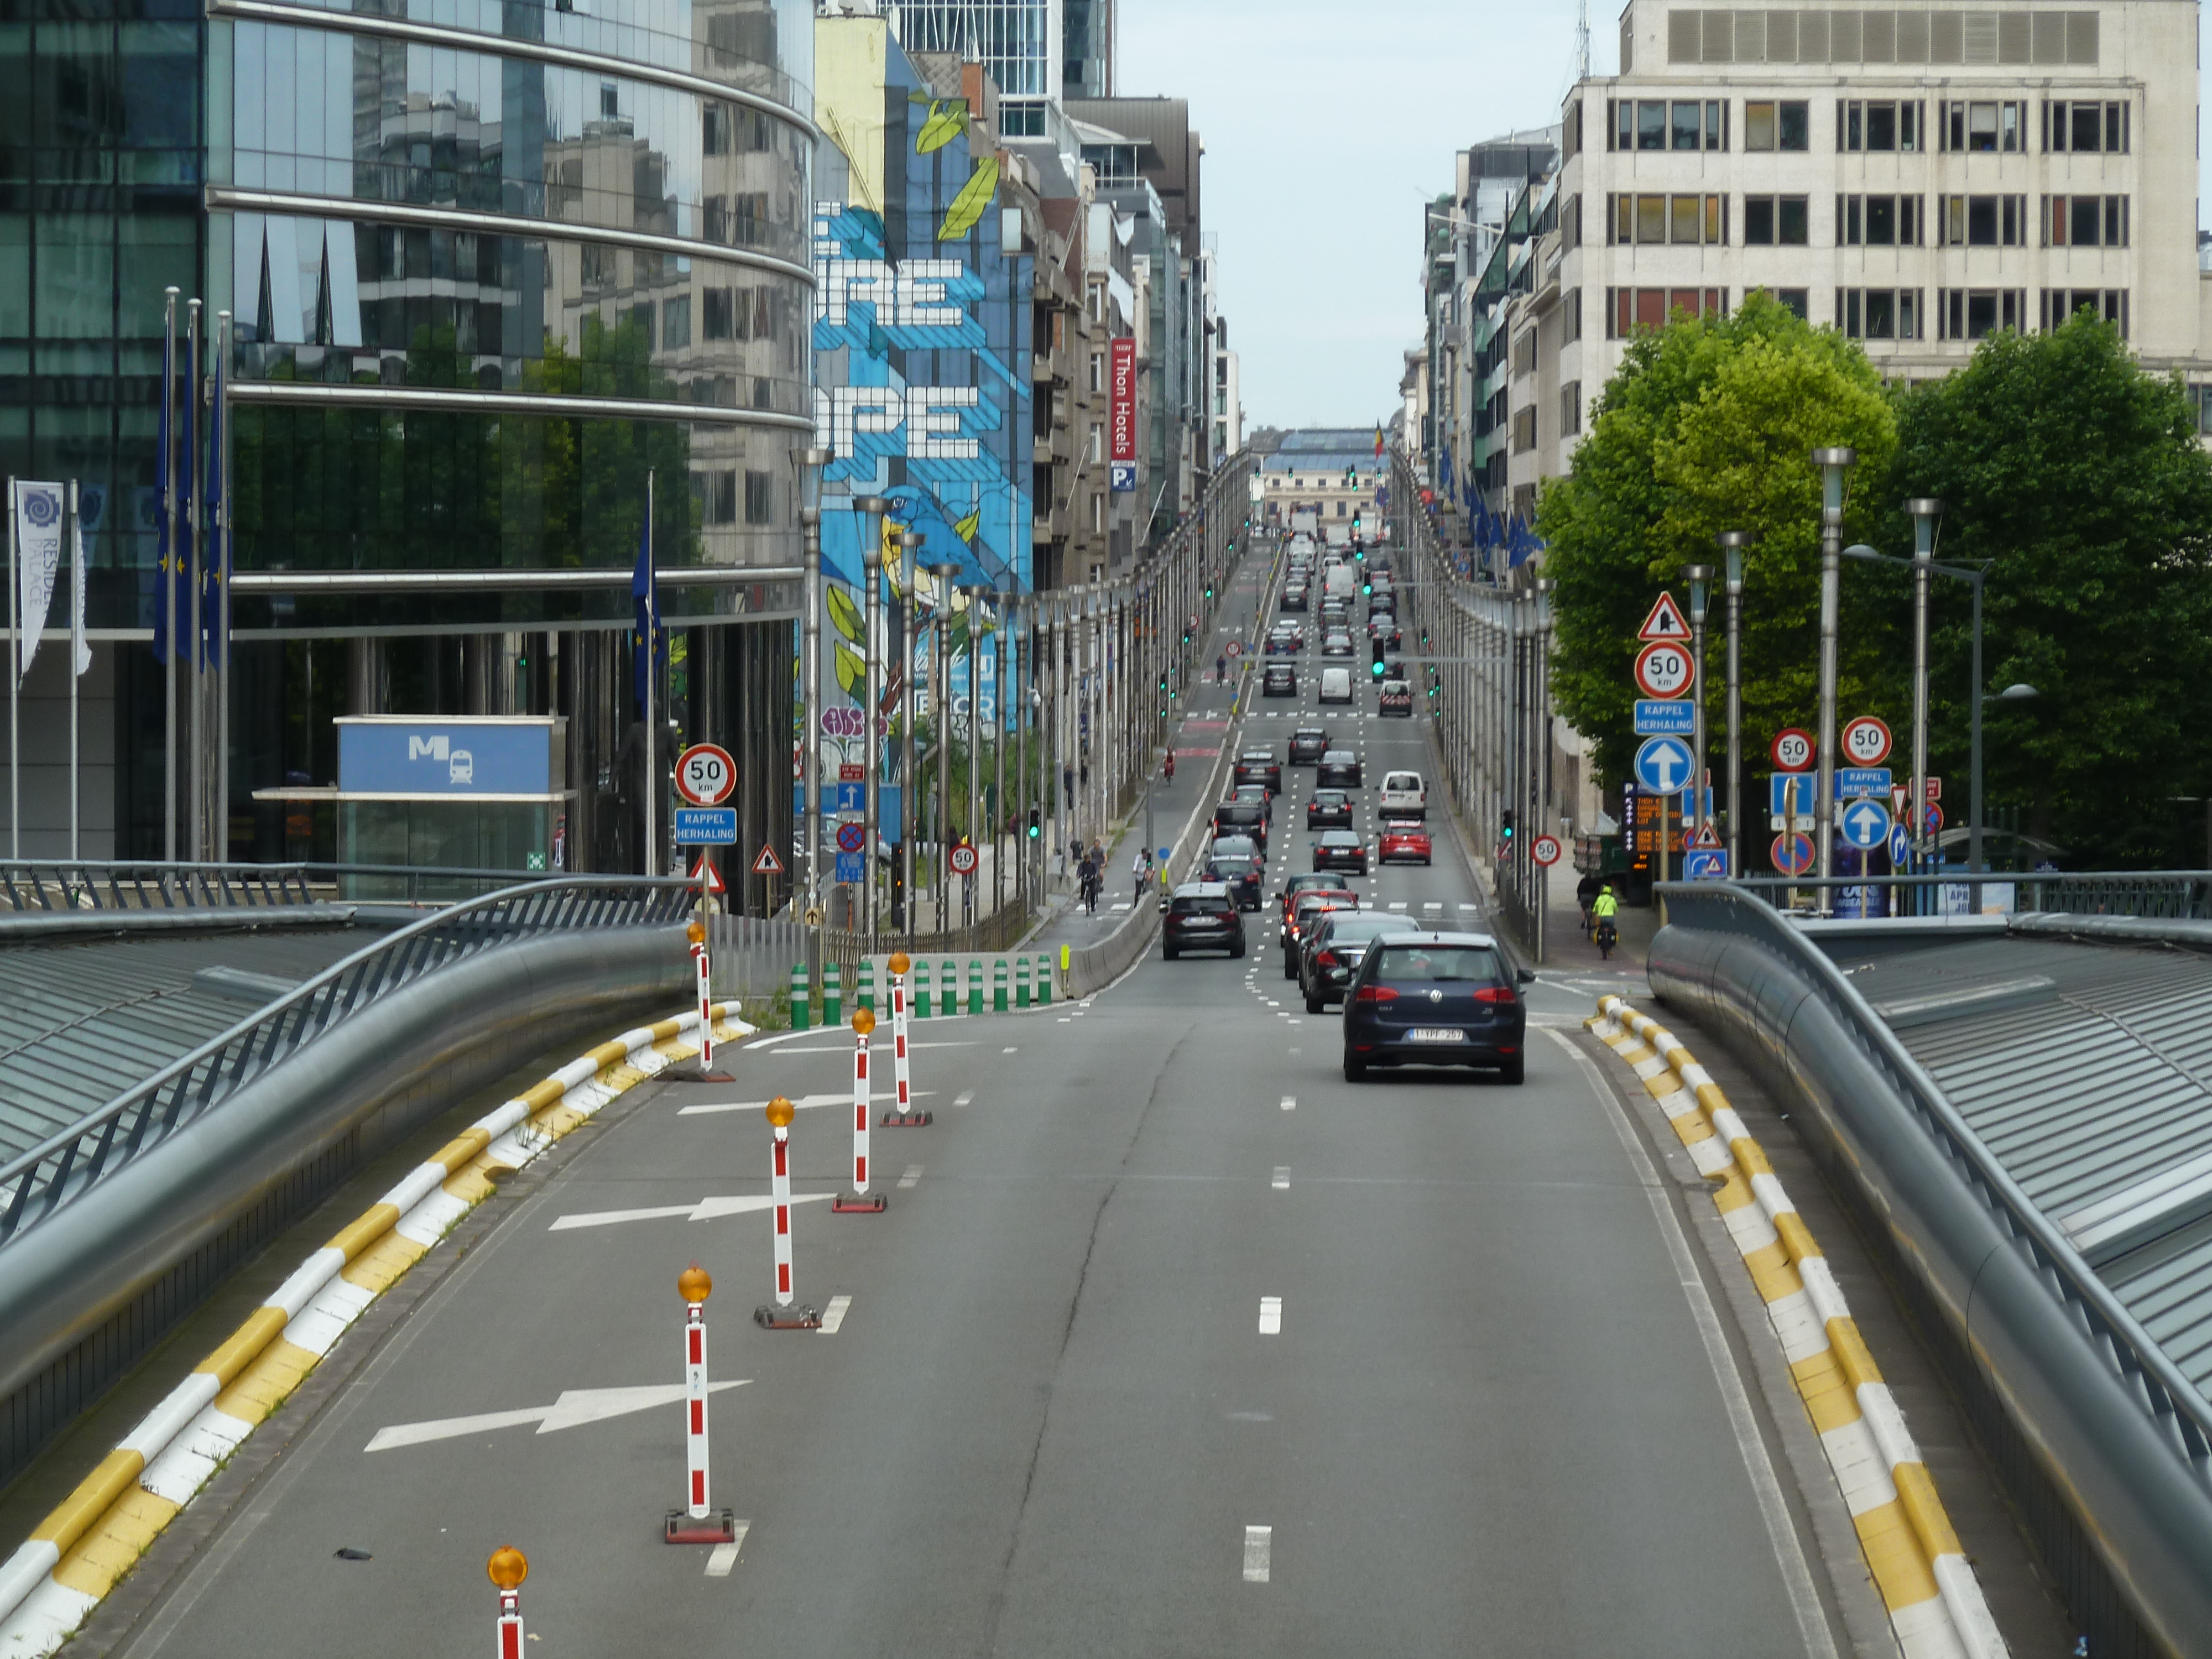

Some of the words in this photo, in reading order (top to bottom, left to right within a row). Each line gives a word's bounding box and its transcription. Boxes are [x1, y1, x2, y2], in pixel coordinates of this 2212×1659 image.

[814, 259, 963, 326] RE
[1117, 354, 1130, 397] Thon
[1117, 402, 1130, 454] Hotels
[1113, 468, 1127, 486] P
[29, 539, 43, 607] PALACE
[1651, 656, 1680, 675] 50
[1658, 678, 1672, 686] km
[1645, 705, 1684, 716] RAPPEL
[1637, 719, 1693, 729] HERHALING
[1855, 729, 1880, 746] 50
[1782, 741, 1805, 755] 50
[691, 760, 721, 780] 50
[1850, 773, 1882, 781] RAPPEL
[698, 782, 713, 791] km
[685, 814, 726, 824] RAPPEL
[677, 829, 734, 839] HERHALING
[1538, 844, 1554, 854] 50
[956, 852, 972, 863] 50
